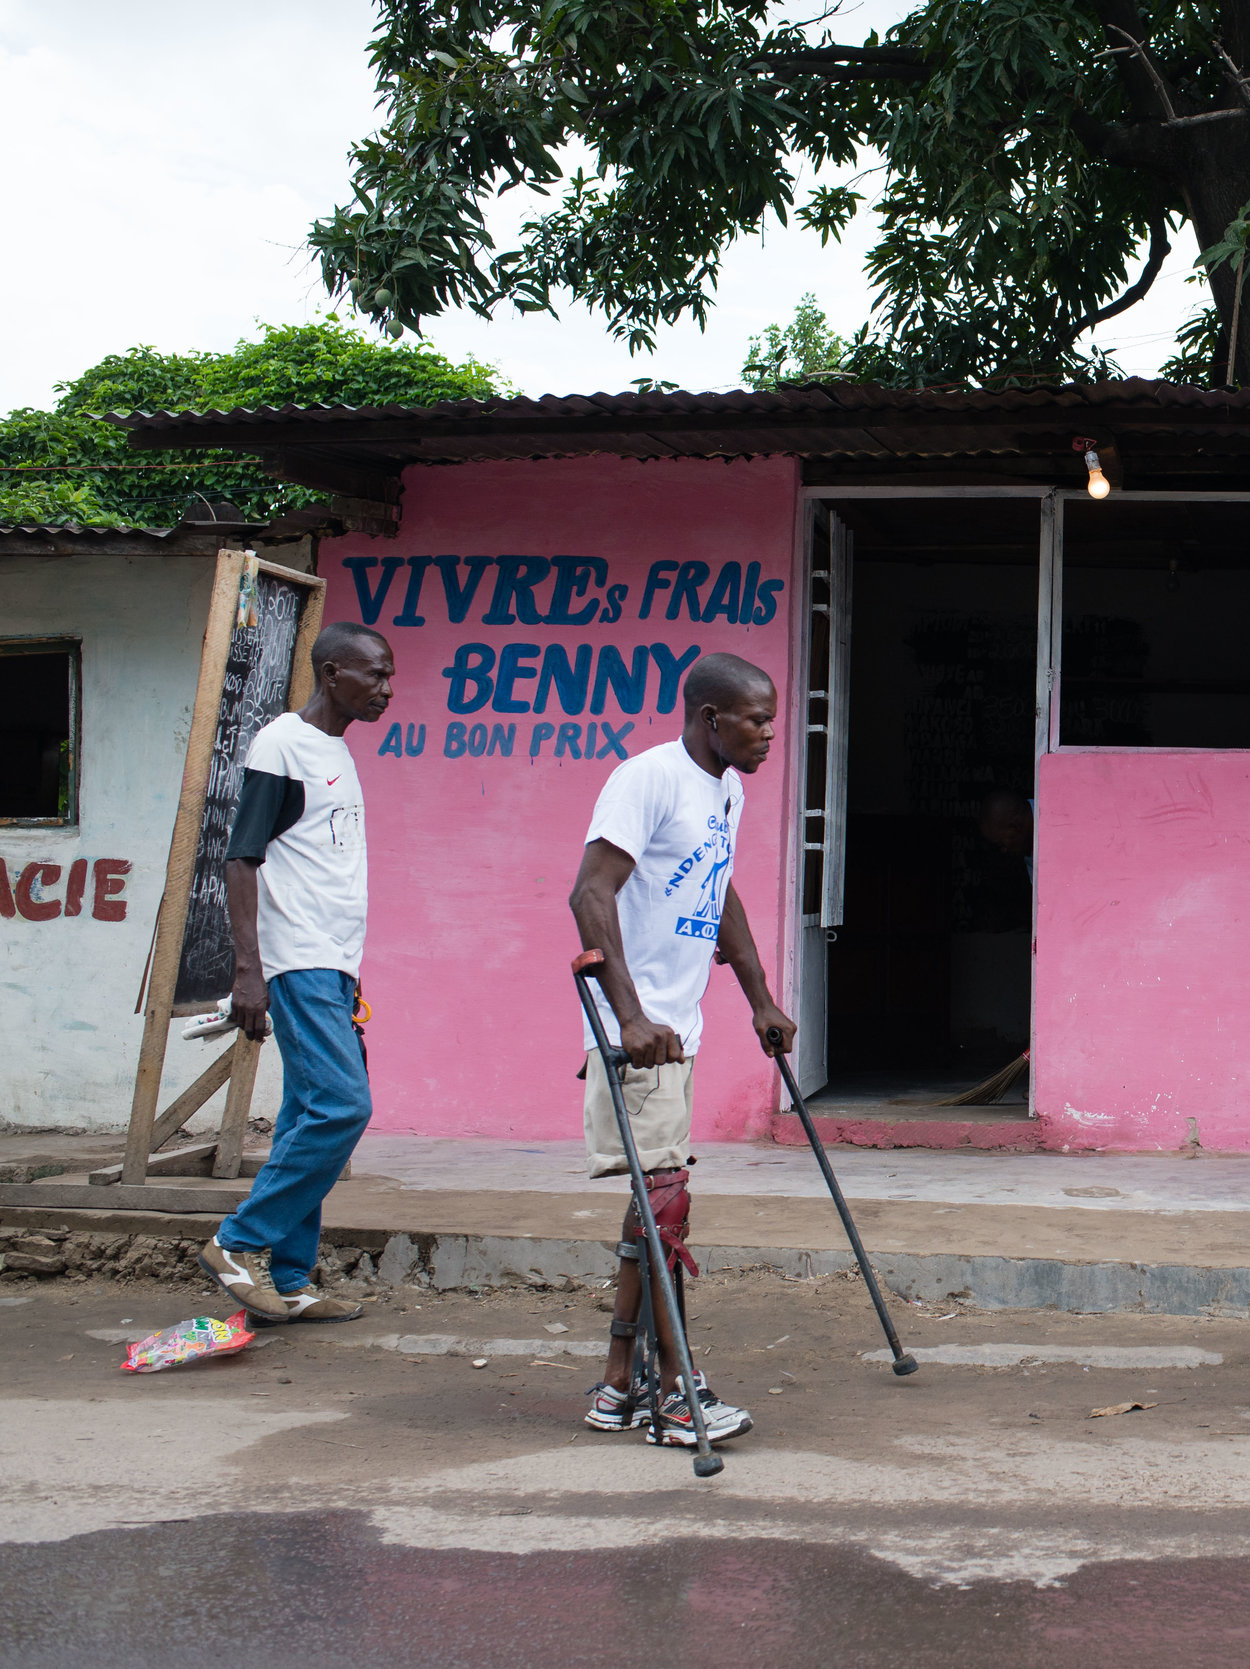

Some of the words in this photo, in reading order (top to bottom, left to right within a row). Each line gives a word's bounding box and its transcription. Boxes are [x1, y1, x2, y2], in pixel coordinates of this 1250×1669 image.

[442, 642, 701, 715] BENNY
[378, 722, 426, 758] AU
[444, 721, 516, 759] BON
[529, 721, 635, 760] PRIX
